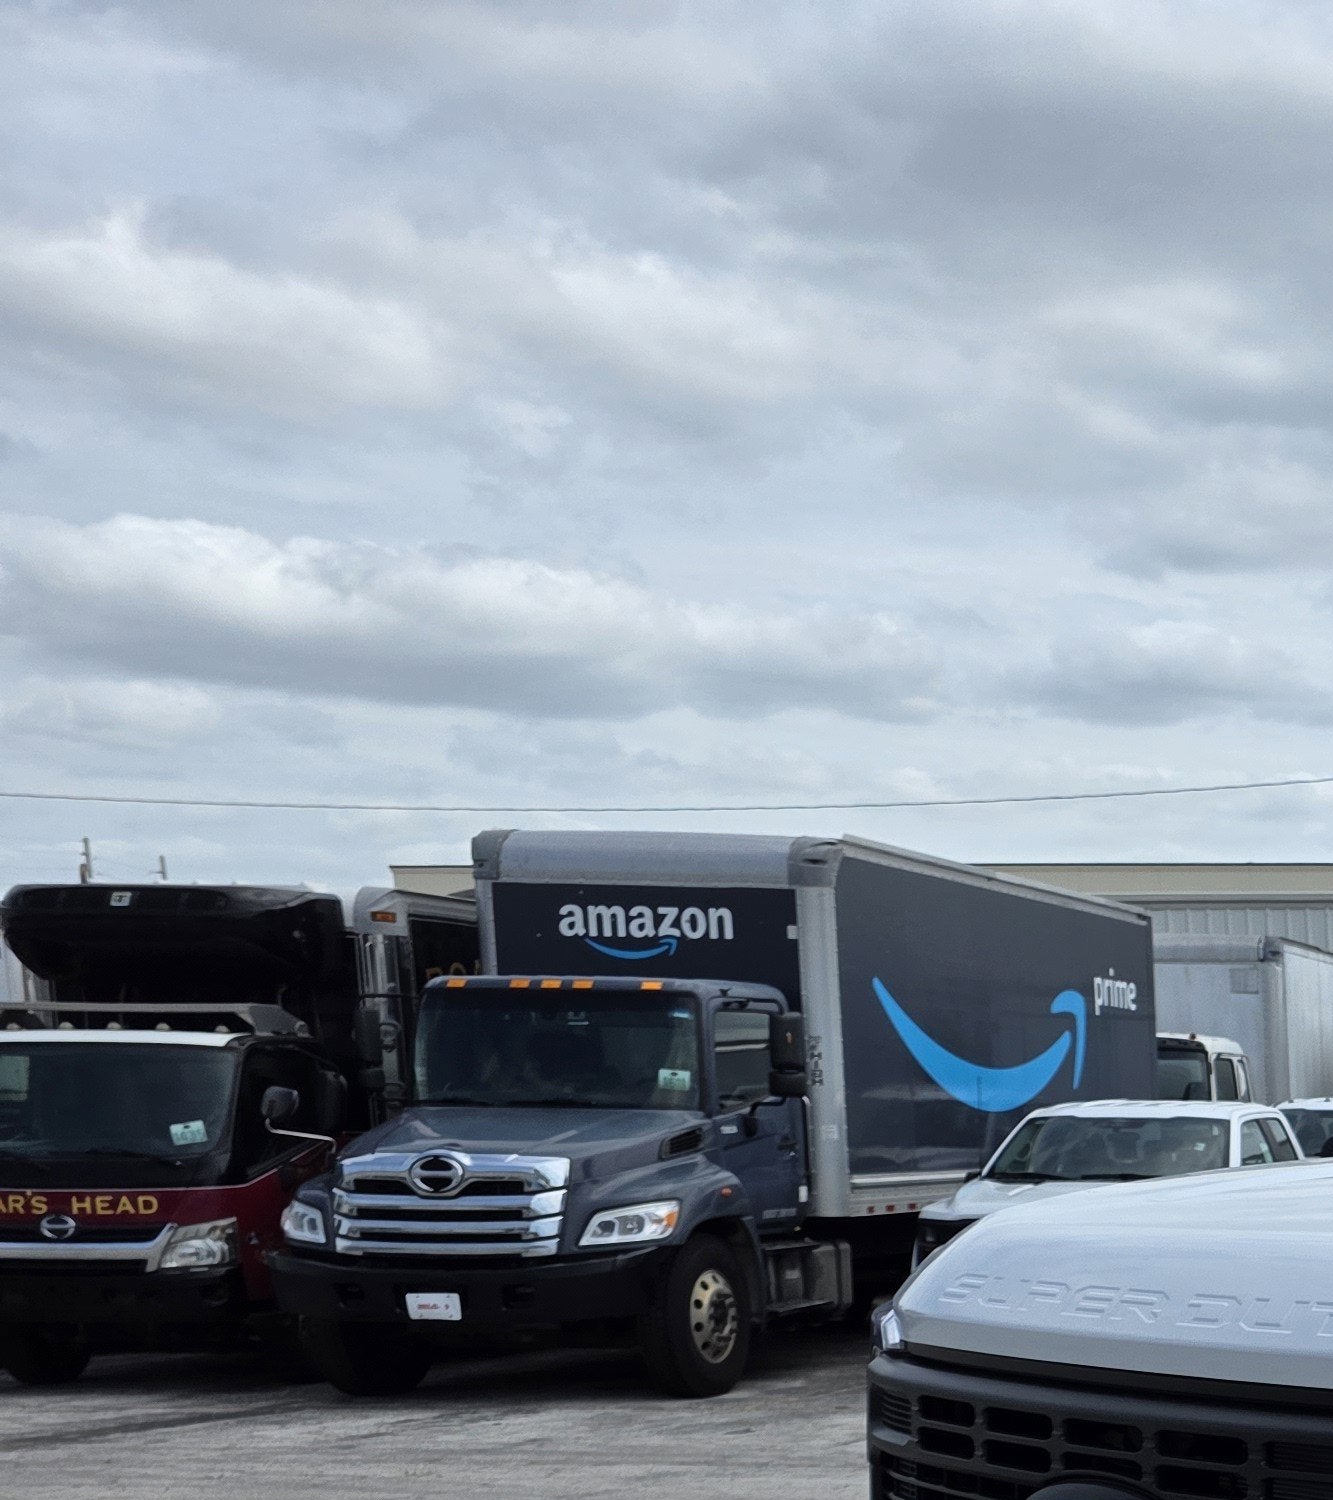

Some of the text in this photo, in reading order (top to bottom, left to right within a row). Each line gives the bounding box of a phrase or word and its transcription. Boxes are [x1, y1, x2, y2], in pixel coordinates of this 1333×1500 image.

[558, 904, 735, 940] amazon
[1093, 967, 1137, 1016] prime
[71, 1194, 159, 1215] HEAD
[938, 1273, 1171, 1324] SUPER
